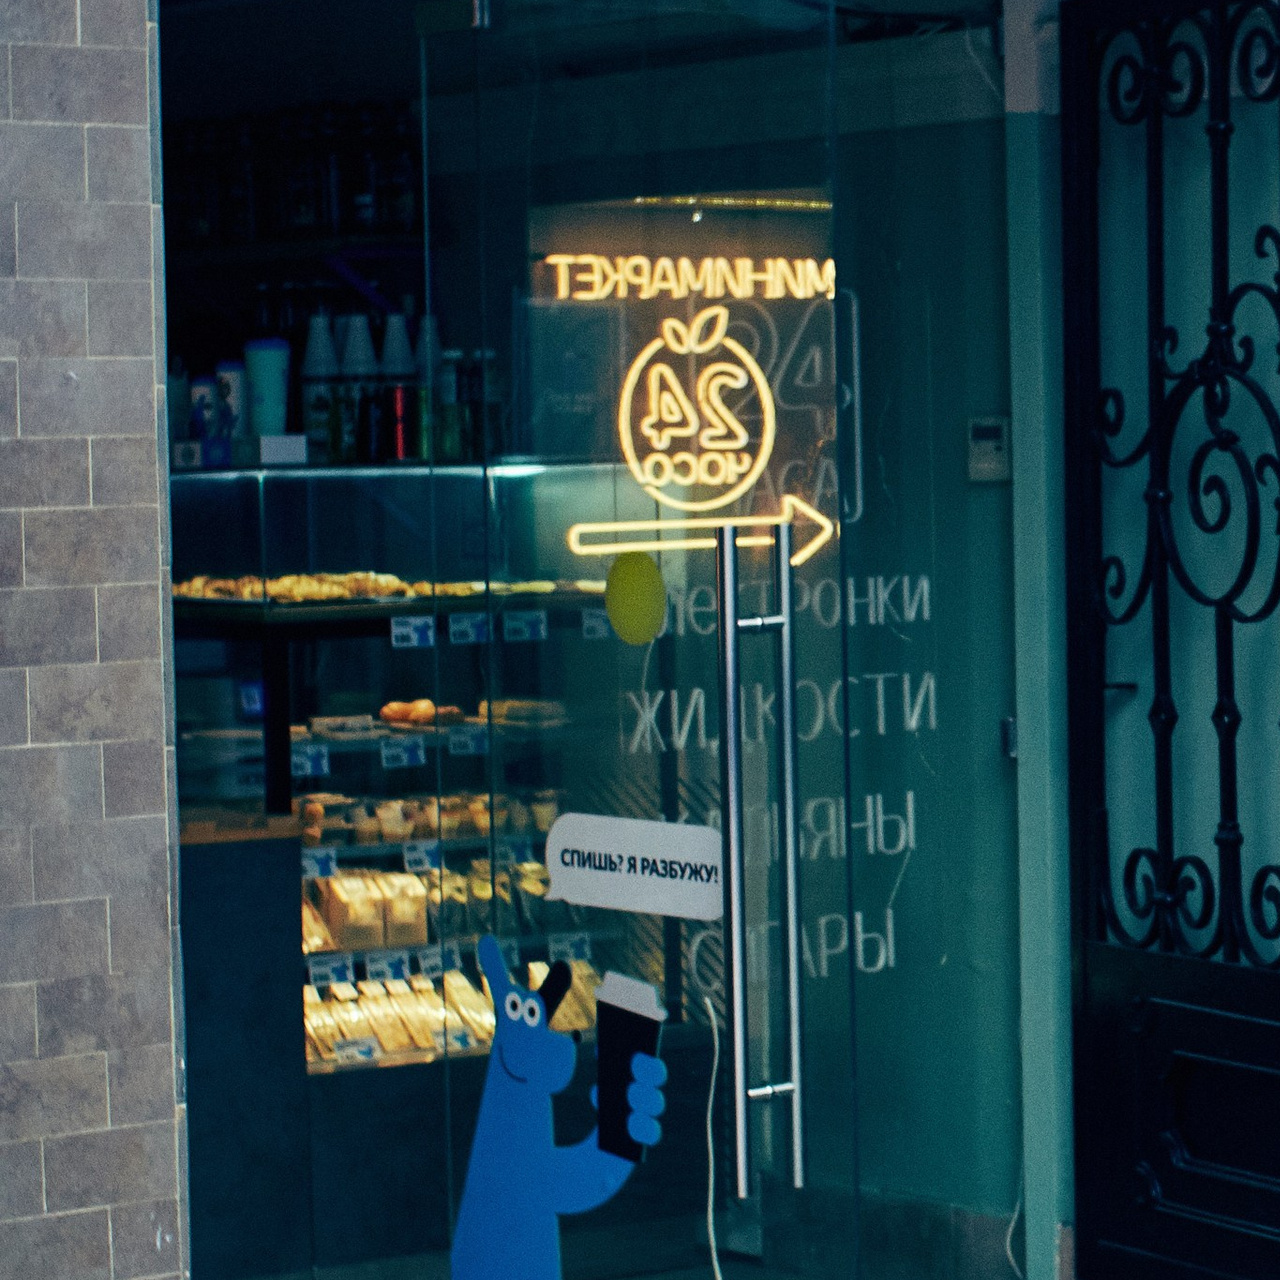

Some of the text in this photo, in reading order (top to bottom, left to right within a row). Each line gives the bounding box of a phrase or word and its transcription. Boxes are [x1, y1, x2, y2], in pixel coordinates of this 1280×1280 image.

[560, 847, 719, 884] СПИШЬ? Я РАЗБУЖУ!
